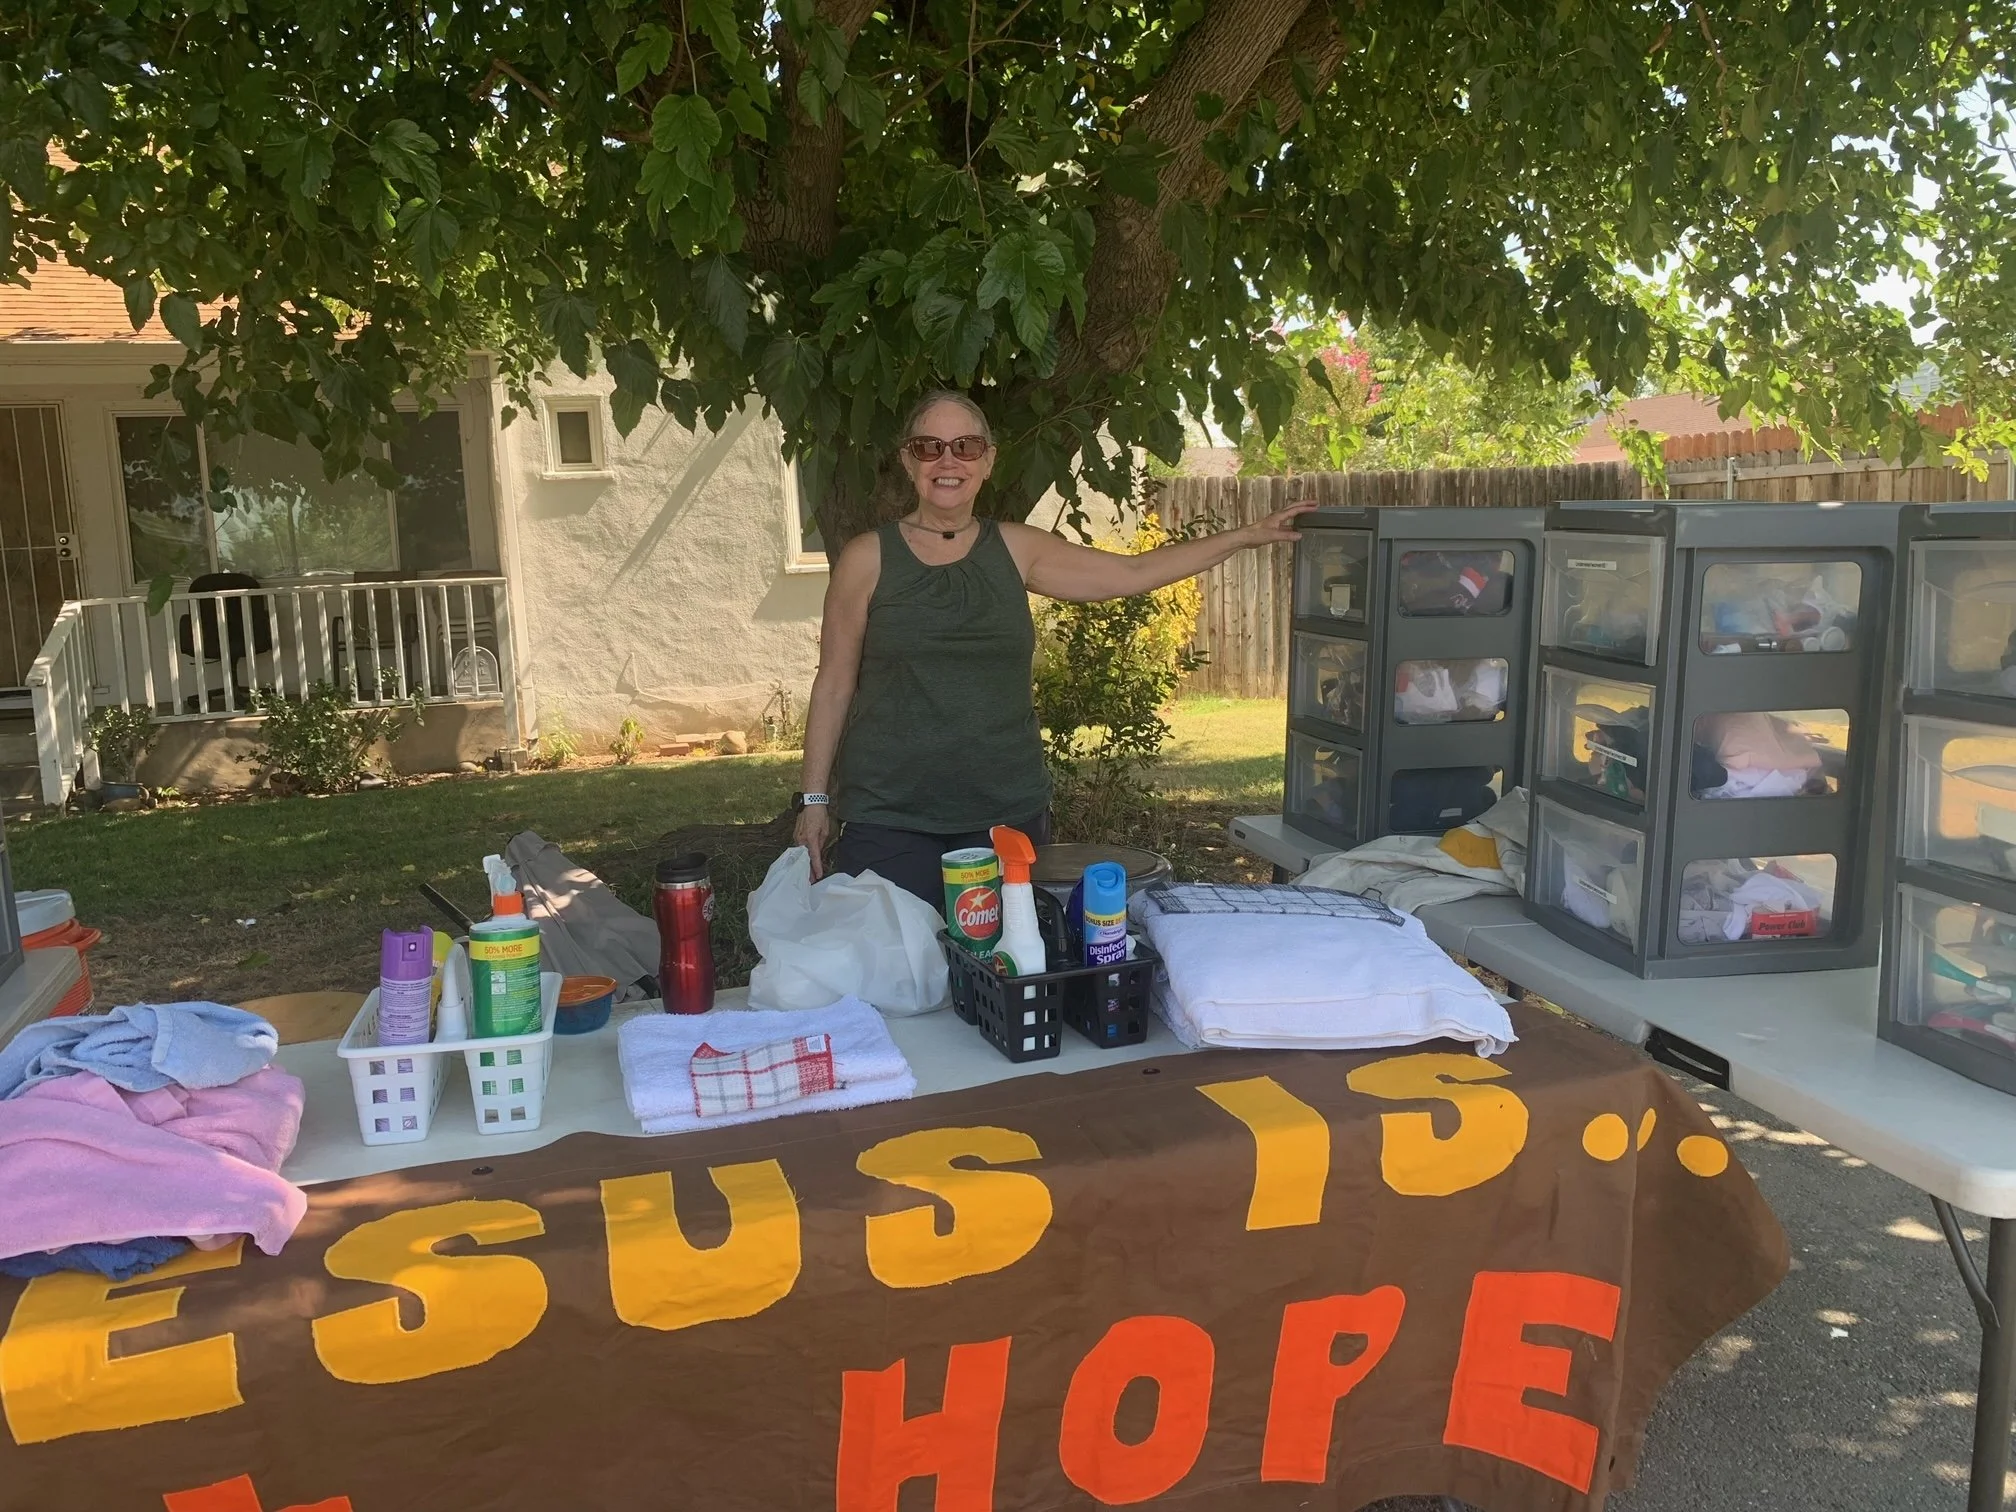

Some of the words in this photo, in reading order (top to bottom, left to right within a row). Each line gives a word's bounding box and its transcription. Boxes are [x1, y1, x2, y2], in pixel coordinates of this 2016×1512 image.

[975, 868, 990, 878] MORE
[958, 903, 999, 927] Comet
[1102, 919, 1115, 927] SIZE
[484, 946, 501, 954] 50%
[501, 943, 523, 954] MORE
[1096, 947, 1126, 965] Spray
[836, 1271, 1620, 1512] HOPE
